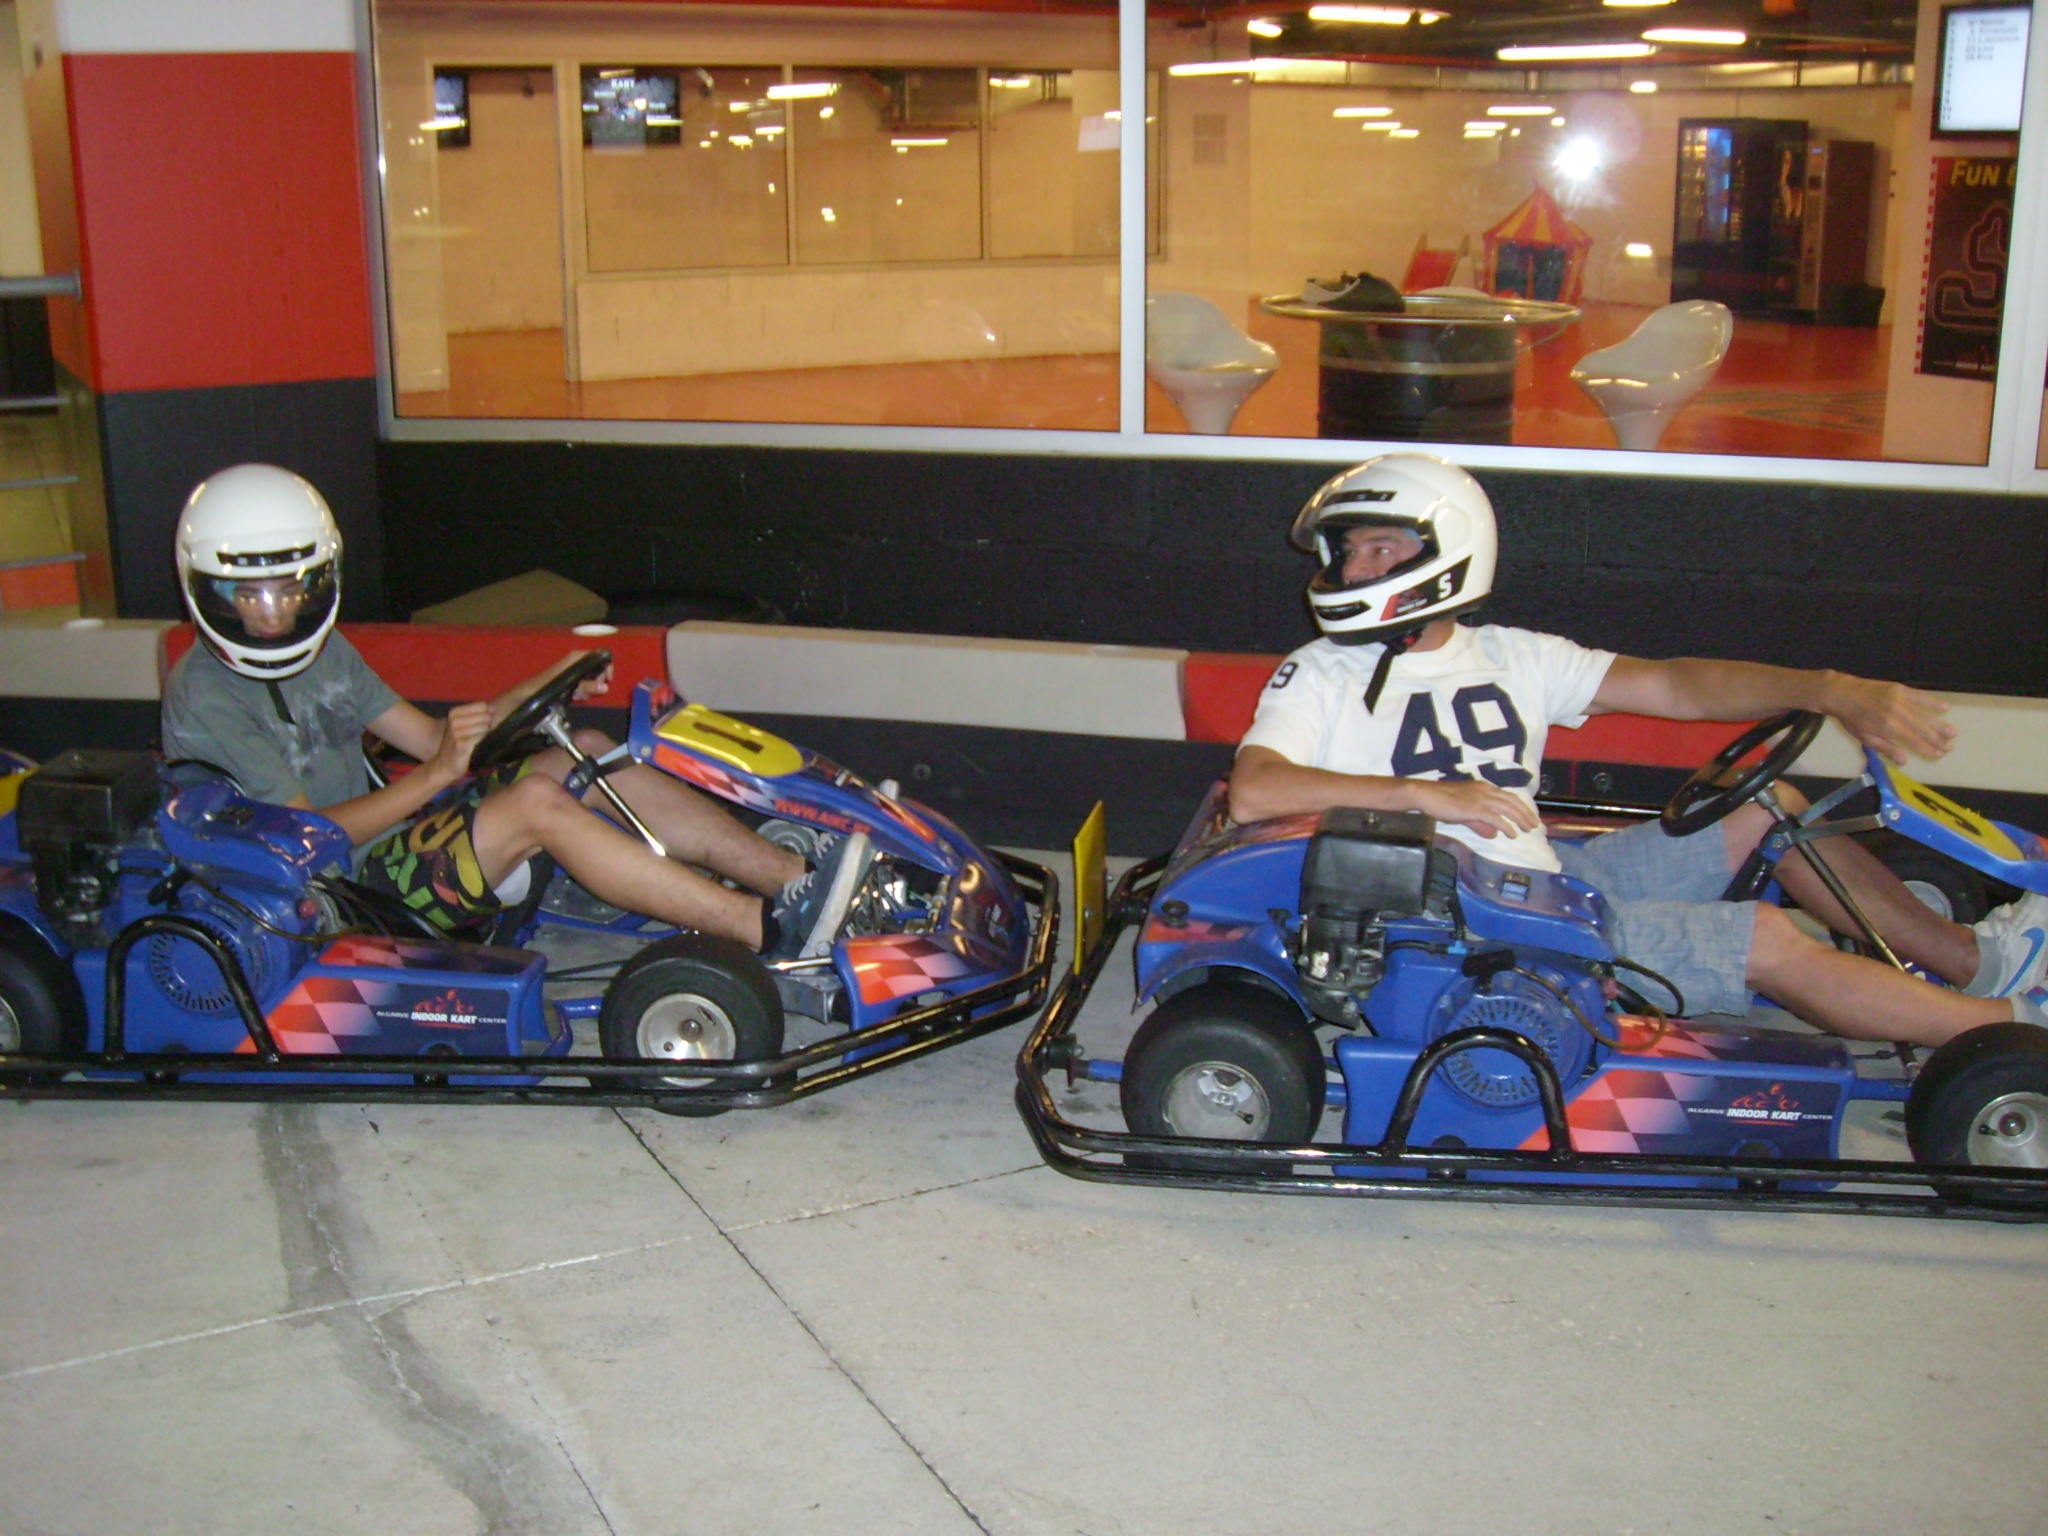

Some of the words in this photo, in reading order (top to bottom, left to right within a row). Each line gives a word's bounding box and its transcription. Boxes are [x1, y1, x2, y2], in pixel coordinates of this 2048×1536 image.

[1950, 160, 2000, 186] FUN
[1271, 662, 1298, 689] 9
[1391, 682, 1533, 787] 49
[410, 1011, 448, 1022] INDOOR
[450, 1013, 478, 1024] KART
[478, 1016, 507, 1024] CENTER
[1687, 1107, 1725, 1115] ALGARVE
[1726, 1107, 1769, 1119] INDOOR
[1770, 1110, 1802, 1121] KART
